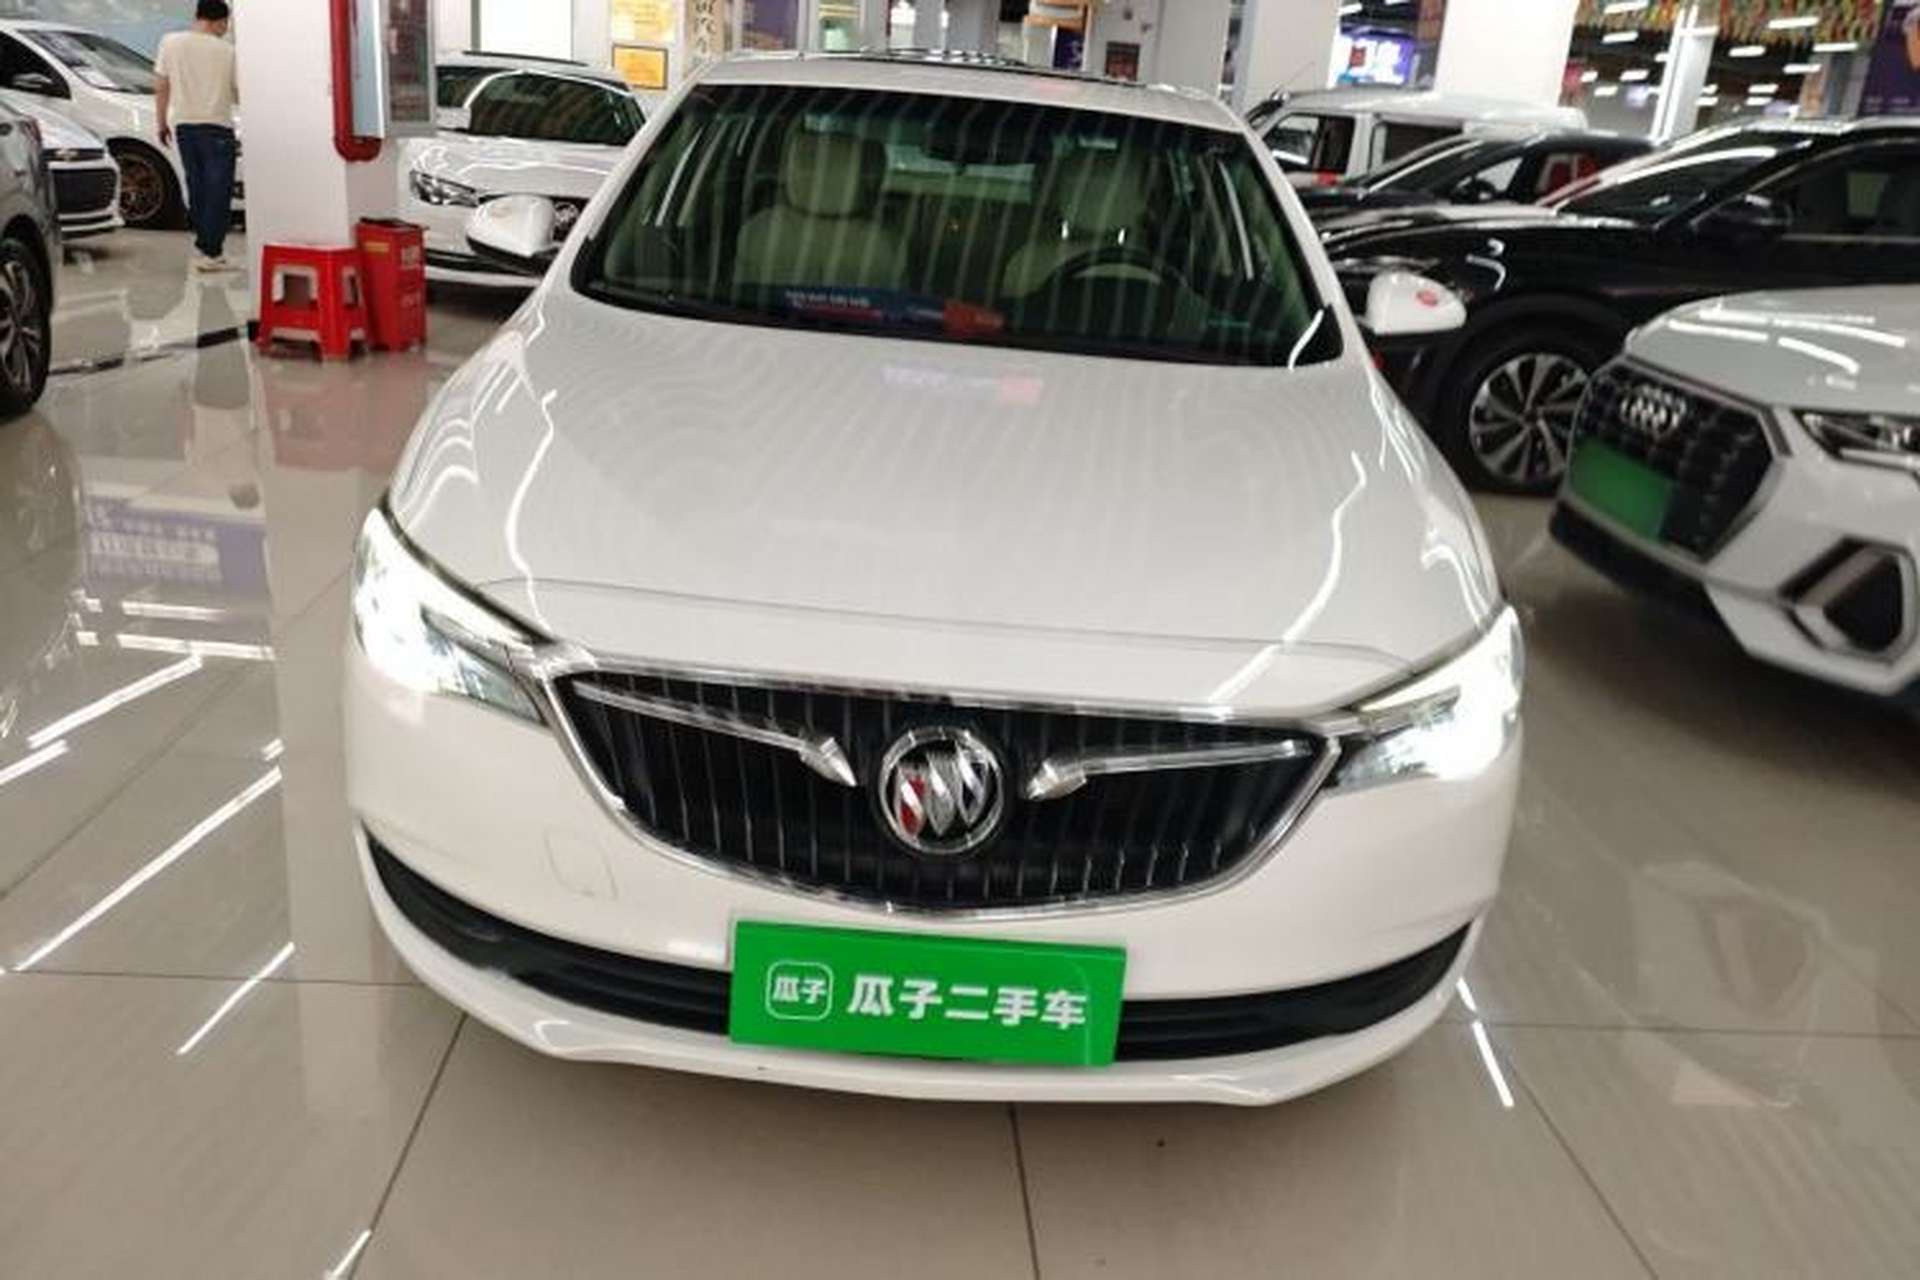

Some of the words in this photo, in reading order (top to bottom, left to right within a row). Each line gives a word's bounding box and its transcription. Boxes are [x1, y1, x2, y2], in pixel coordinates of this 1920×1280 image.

[772, 976, 827, 1004] 瓜子
[847, 973, 1087, 1030] 瓜子二手车
